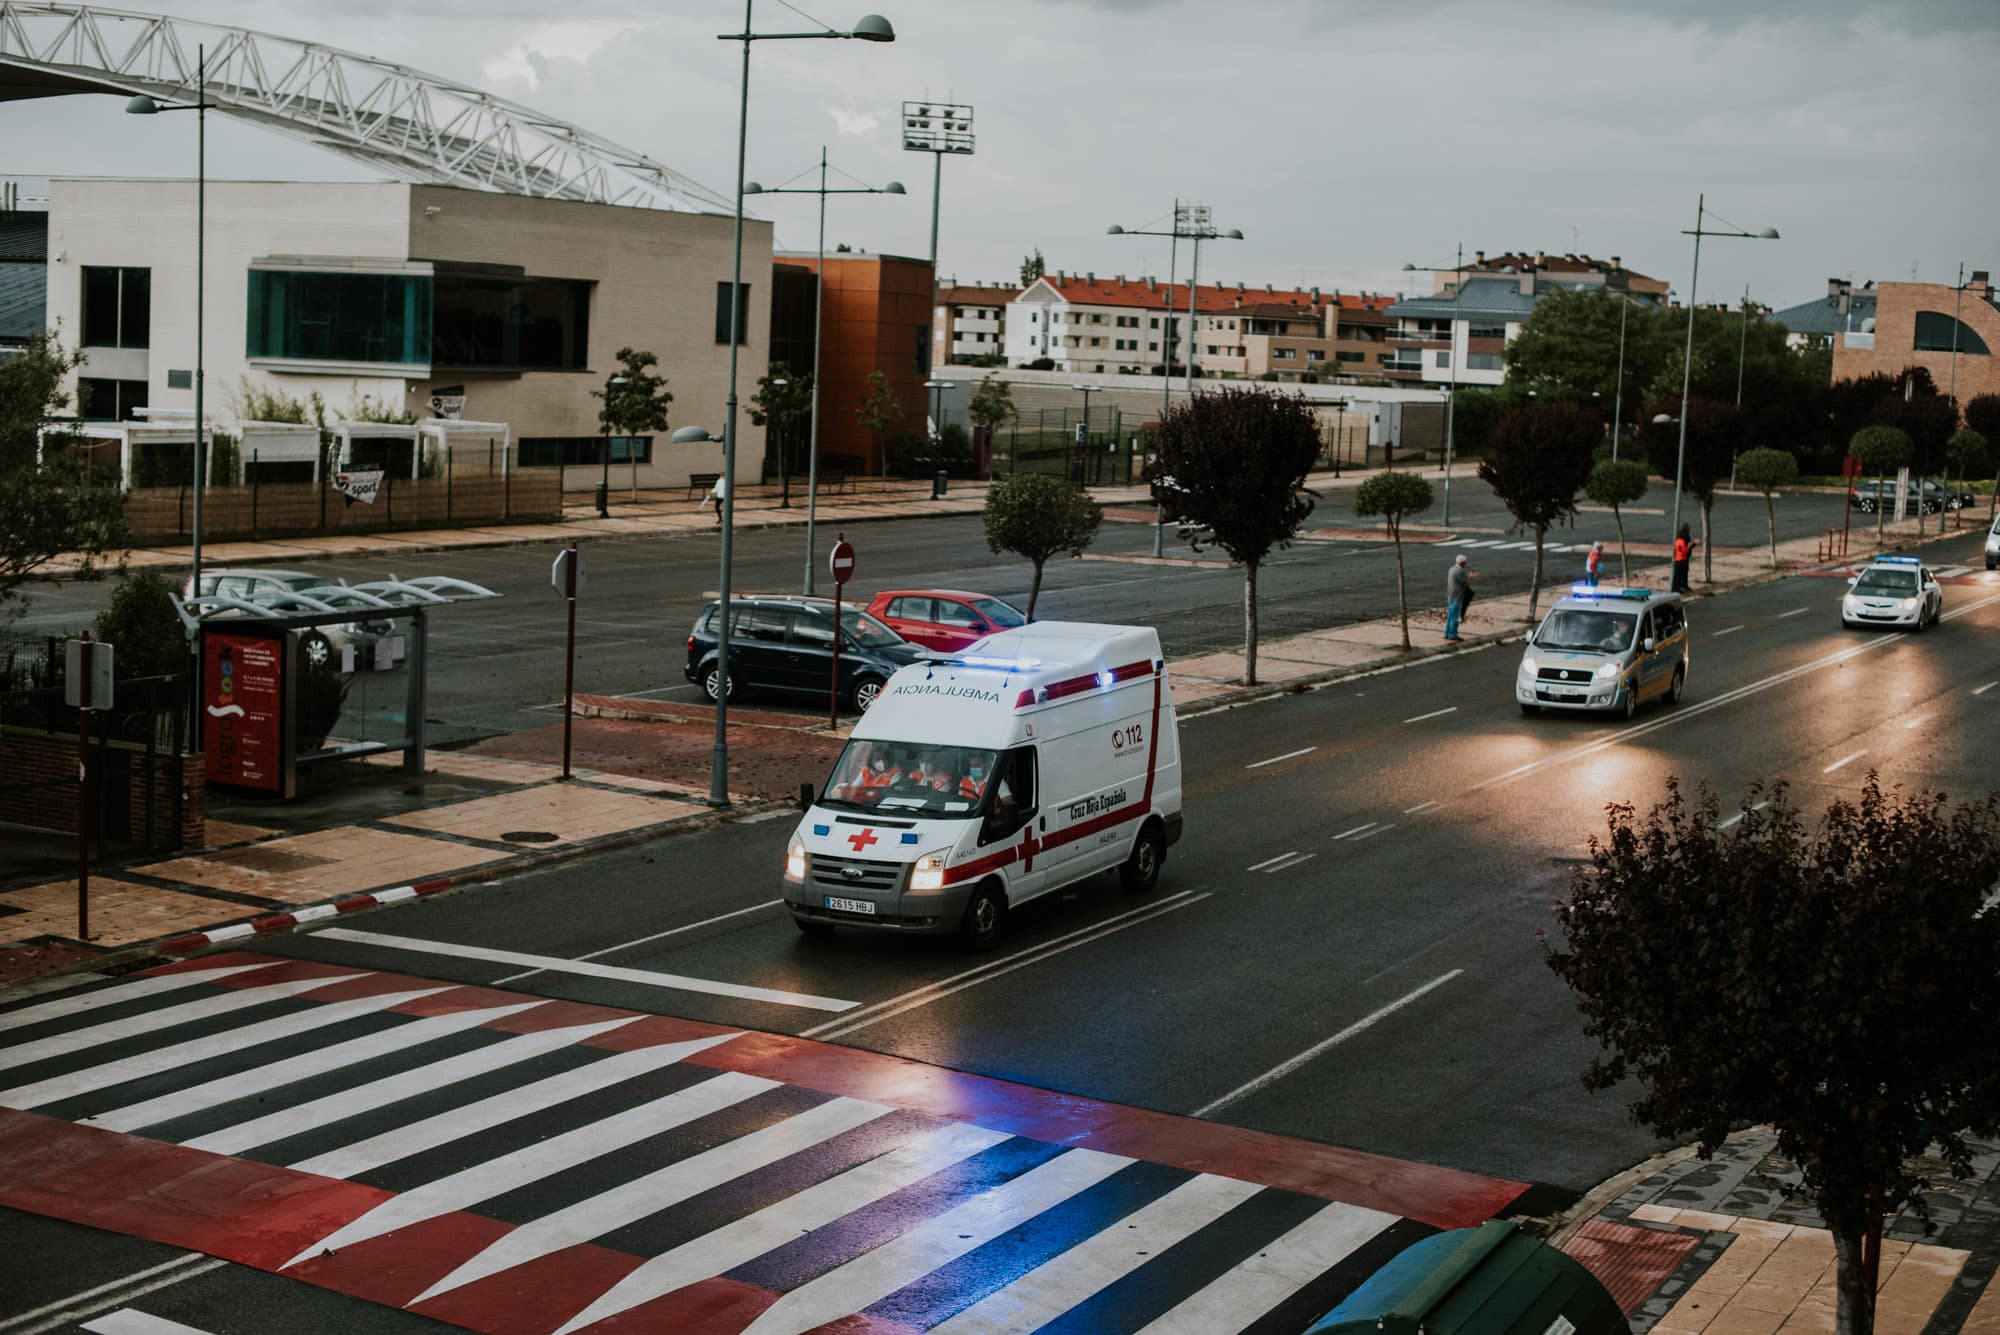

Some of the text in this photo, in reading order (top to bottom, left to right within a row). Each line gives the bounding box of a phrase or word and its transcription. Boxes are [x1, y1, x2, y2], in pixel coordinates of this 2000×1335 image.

[352, 481, 377, 499] sport
[1126, 724, 1143, 745] 112
[1070, 788, 1126, 820] Cruz Roja Española
[831, 899, 873, 912] 2615 HBJ
